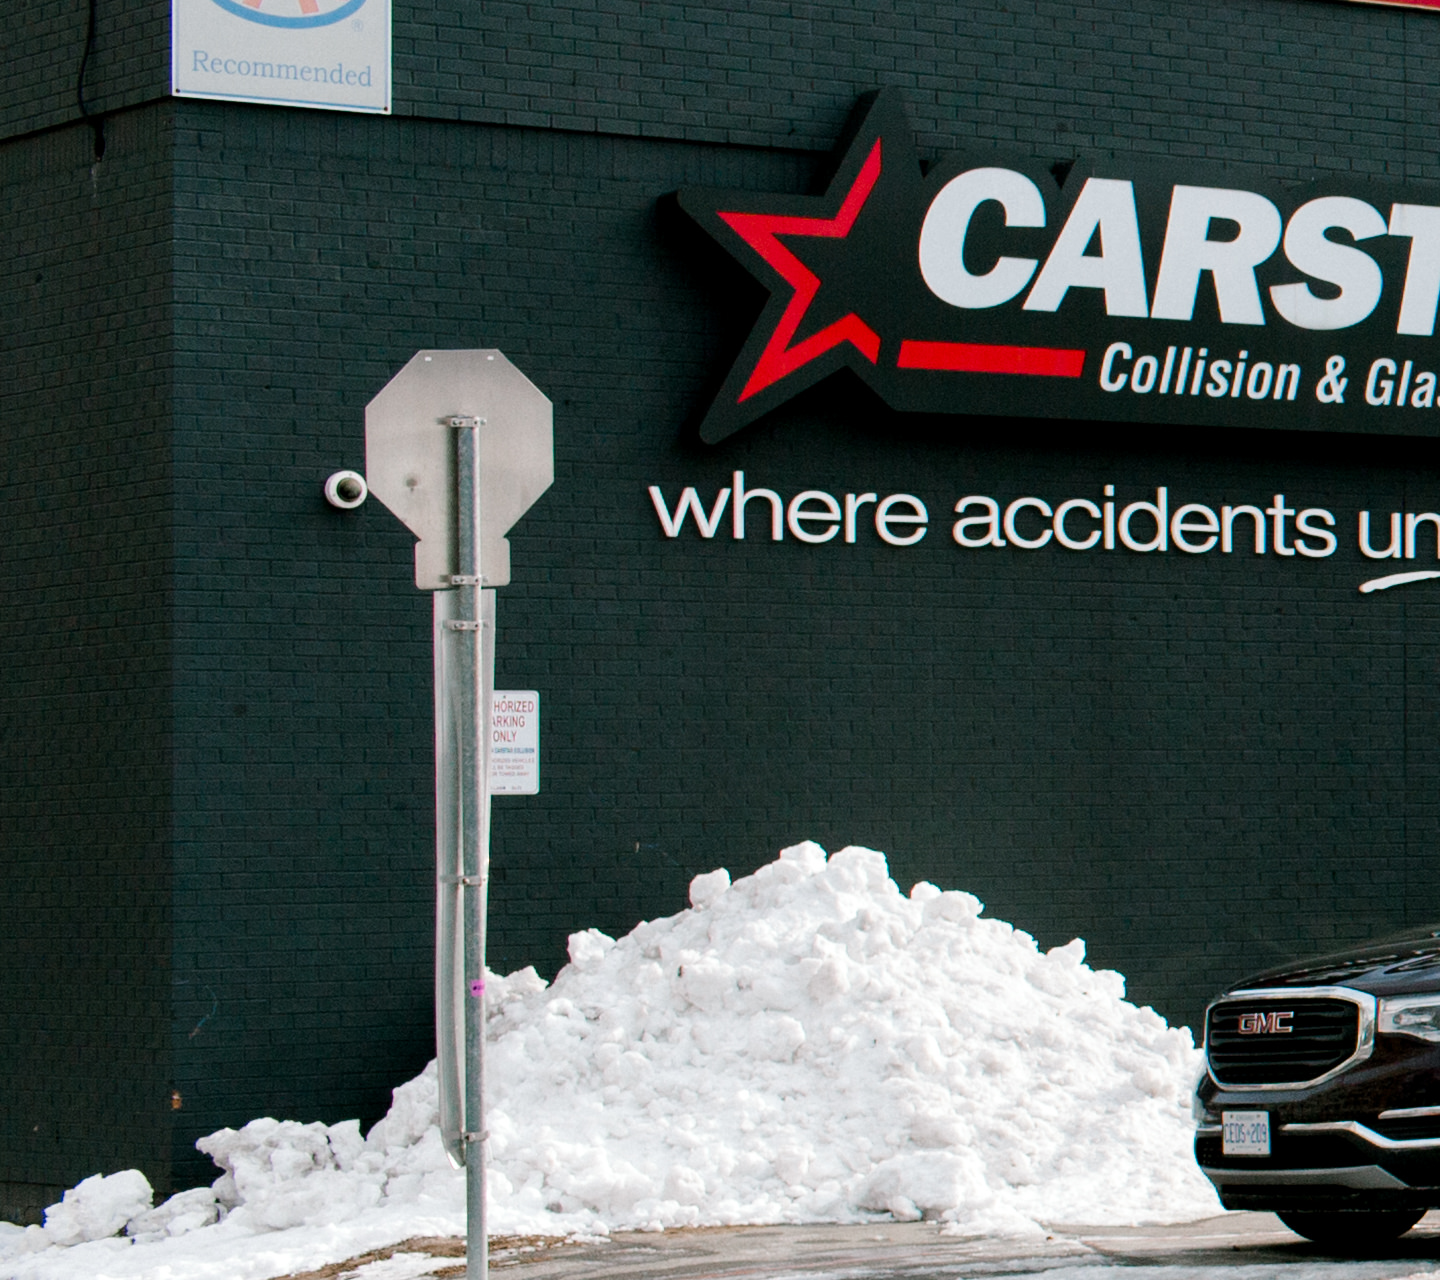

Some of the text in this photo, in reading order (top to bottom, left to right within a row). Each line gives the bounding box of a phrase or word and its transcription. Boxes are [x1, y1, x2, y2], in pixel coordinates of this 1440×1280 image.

[192, 50, 372, 88] Recommended
[1100, 342, 1299, 402] Collision
[1316, 356, 1346, 404] &
[649, 471, 927, 543] where
[952, 487, 1337, 558] accidents
[494, 701, 534, 713] HORIZED
[493, 730, 517, 742] ONLY
[1238, 1011, 1294, 1035] GMC
